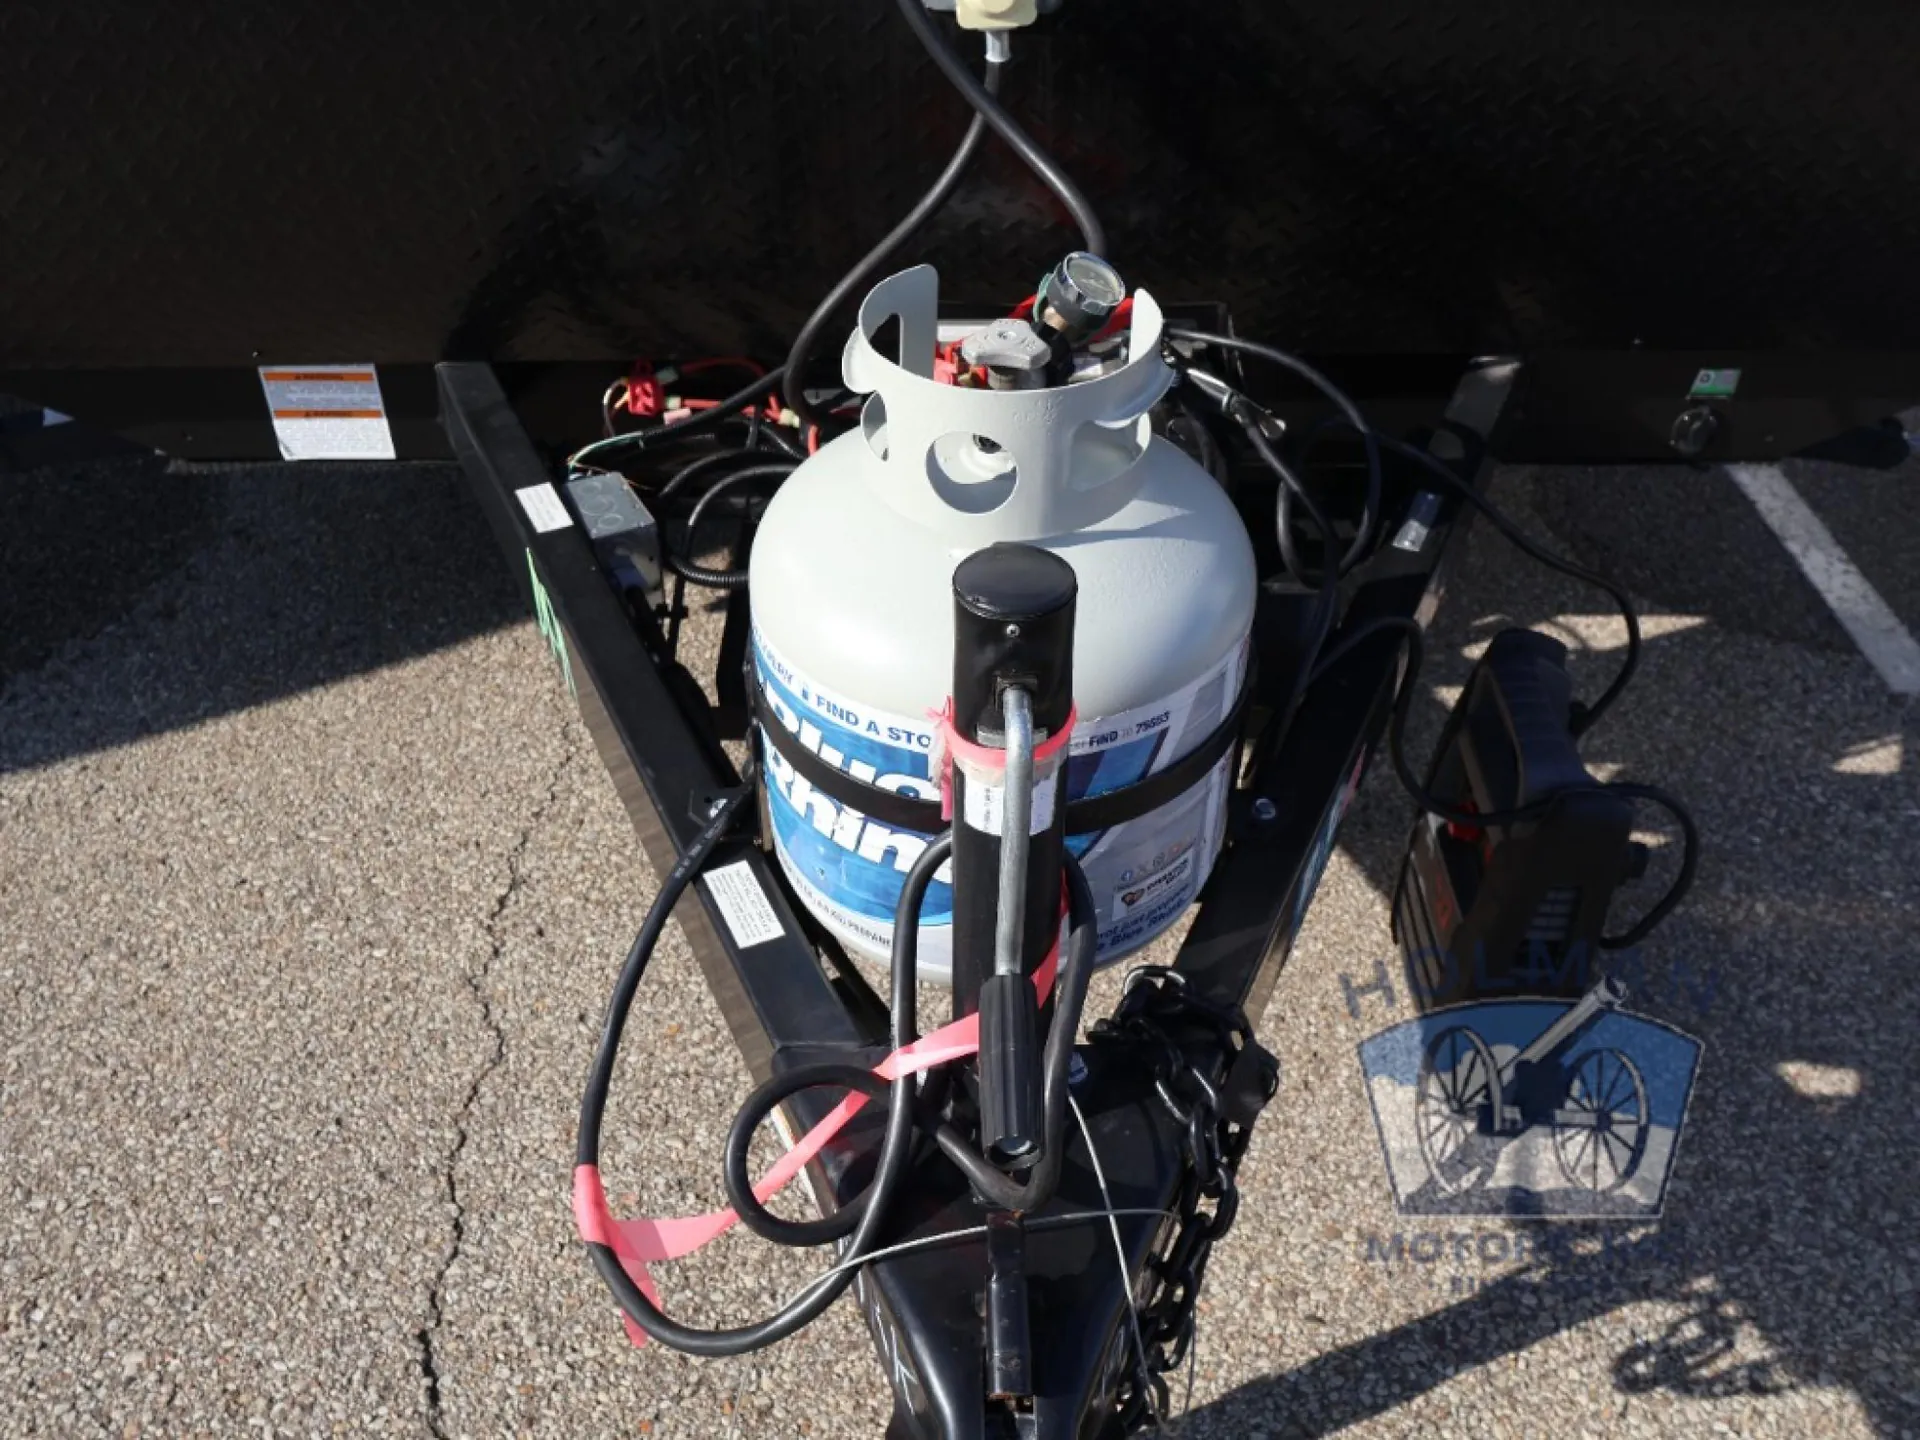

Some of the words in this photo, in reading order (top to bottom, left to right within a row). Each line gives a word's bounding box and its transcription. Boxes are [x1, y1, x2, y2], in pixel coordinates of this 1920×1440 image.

[815, 693, 860, 726] FIND
[866, 721, 880, 735] A
[887, 726, 931, 747] STO
[1089, 730, 1118, 747] FIND
[761, 722, 952, 884] Rhin
